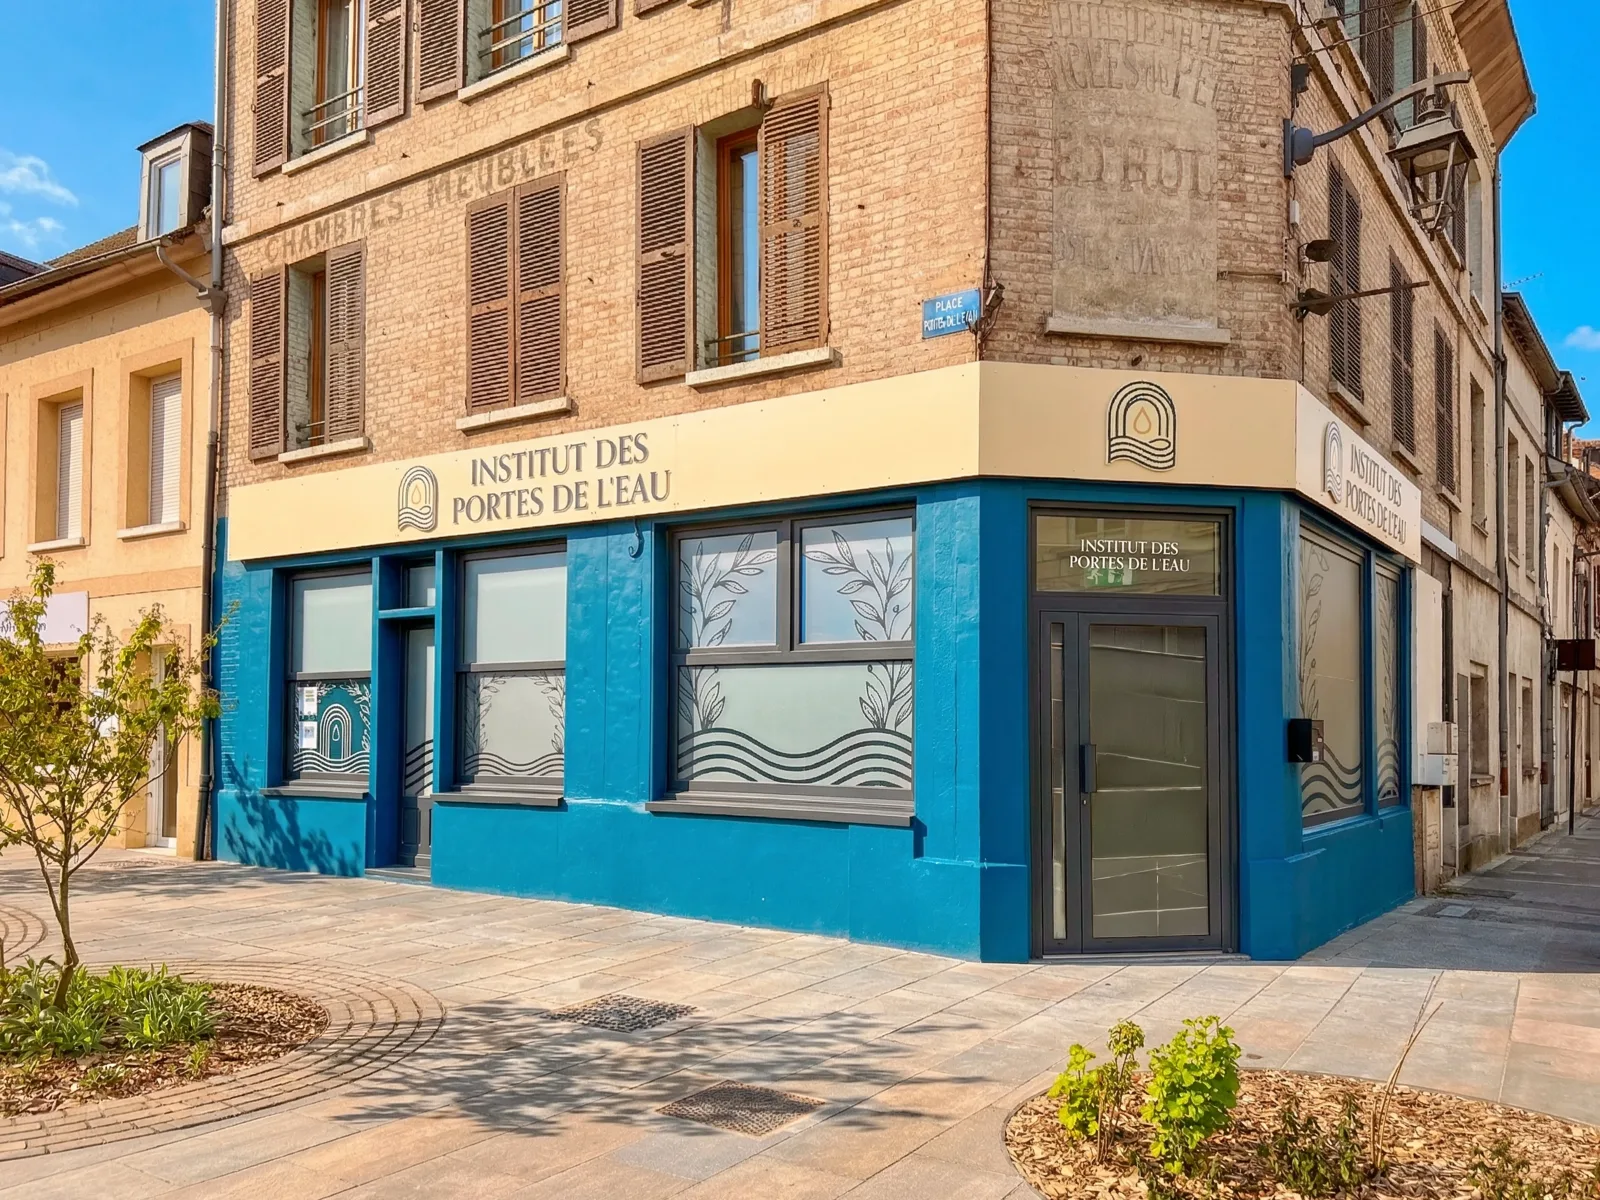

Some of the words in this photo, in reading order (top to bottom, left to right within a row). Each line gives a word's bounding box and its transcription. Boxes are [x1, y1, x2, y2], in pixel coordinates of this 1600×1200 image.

[266, 197, 404, 264] CHAMBRES
[935, 296, 963, 313] PLACE
[470, 442, 587, 486] INSTITUT
[595, 433, 650, 470] DES
[1350, 443, 1387, 496] INSTITUT
[1388, 474, 1402, 507] DES
[453, 487, 544, 525] PORTES
[552, 480, 589, 514] DE
[597, 469, 672, 508] L'EAU
[1345, 480, 1376, 524] PORTES
[1377, 502, 1387, 533] DE
[1388, 510, 1407, 545] L'EAU
[1069, 555, 1124, 570] PORTES
[1128, 557, 1148, 571] DE
[1152, 558, 1190, 572] L'EAU
[1081, 539, 1147, 554] INSTITUT
[1151, 541, 1178, 555] DES
